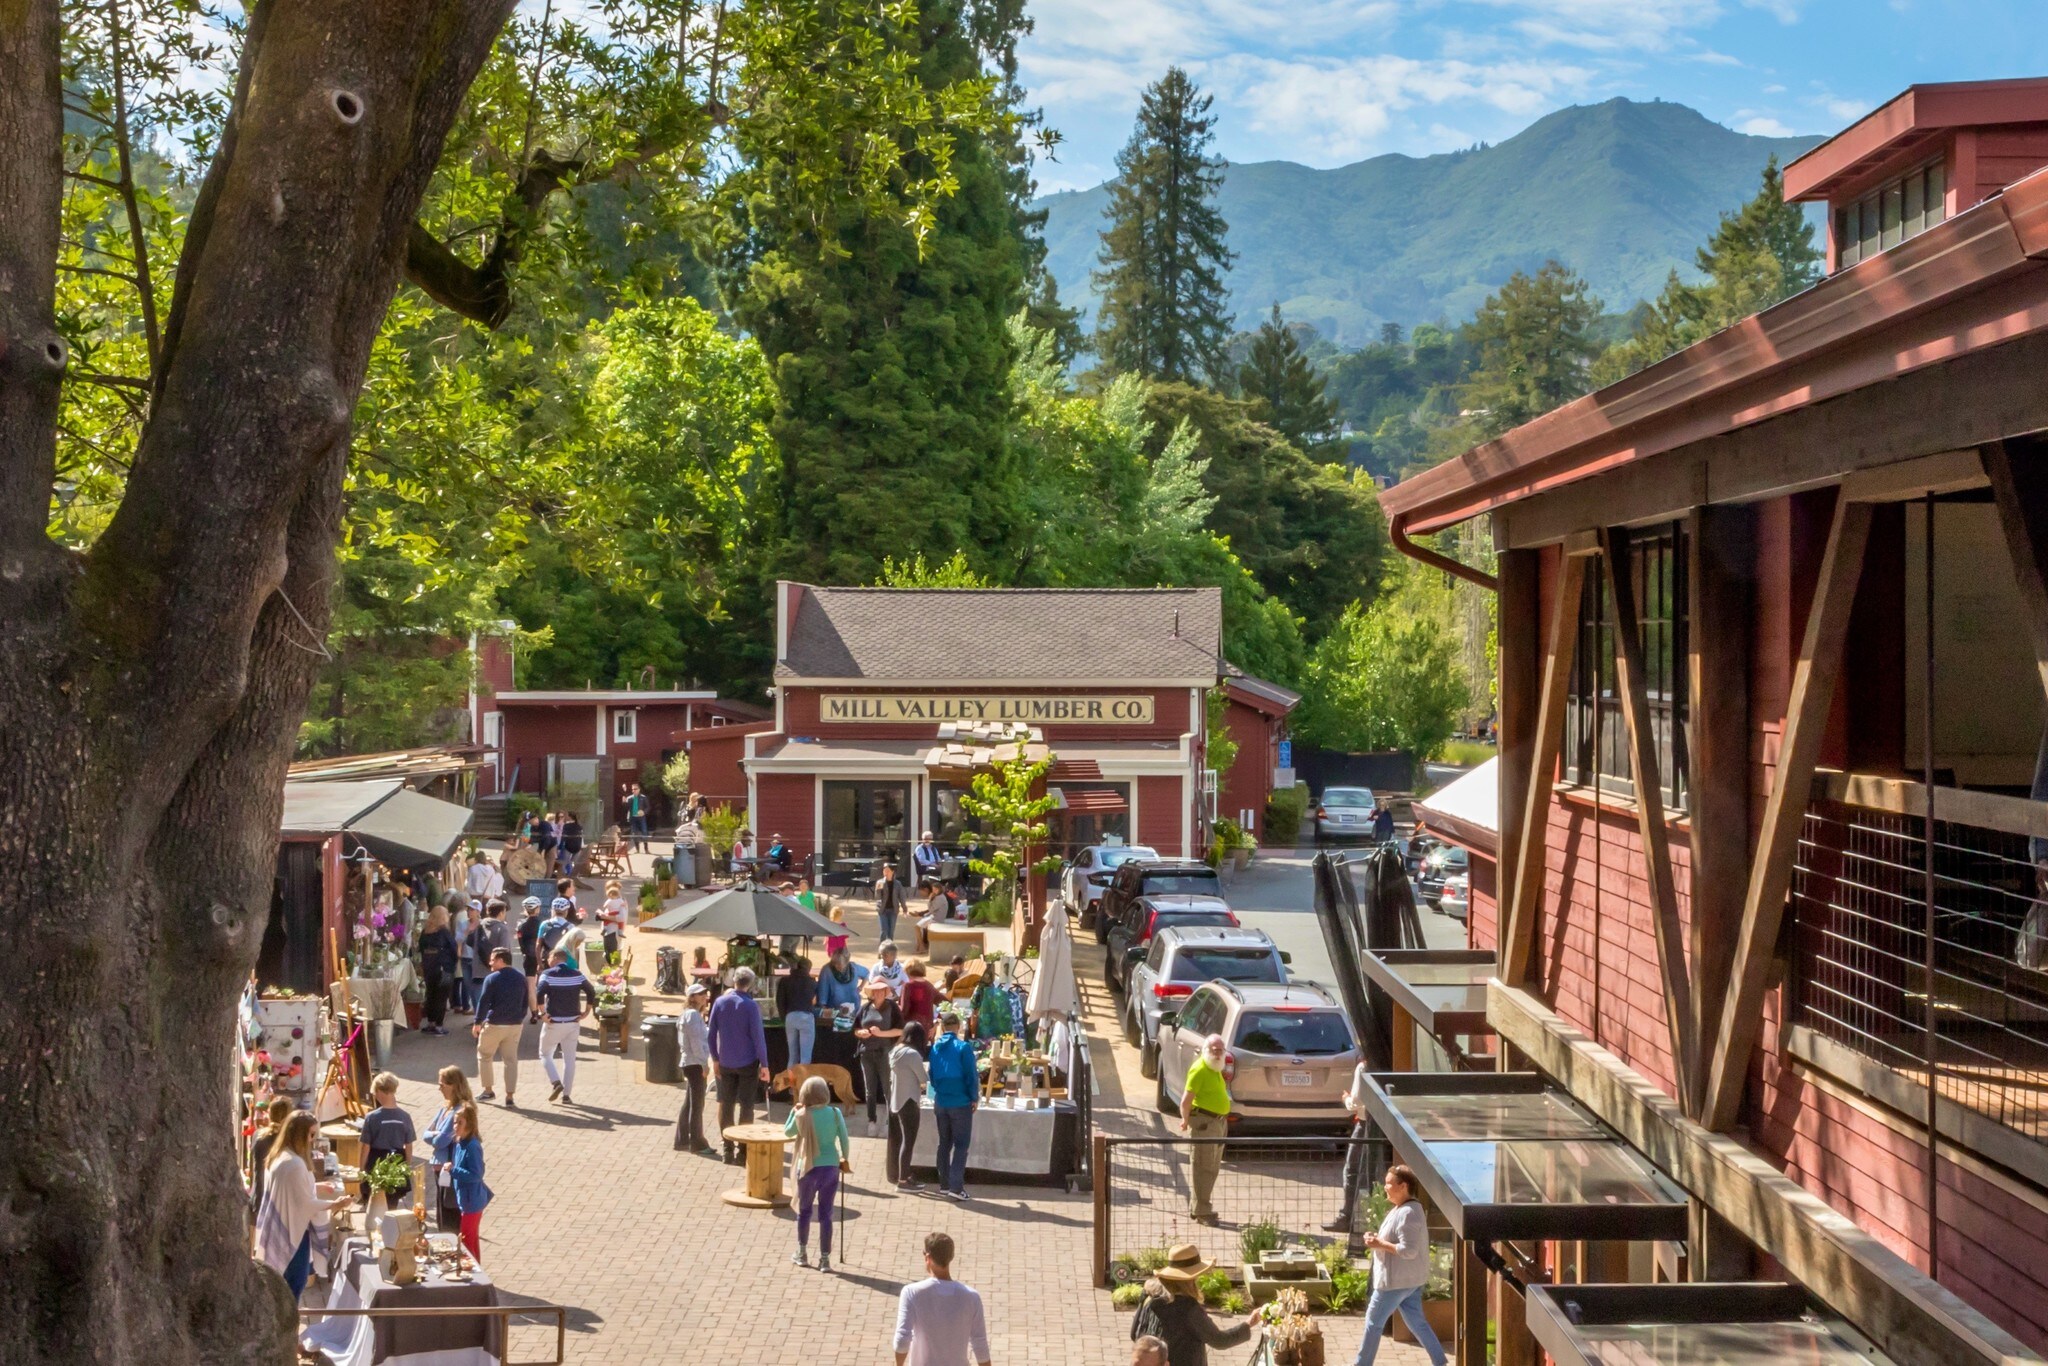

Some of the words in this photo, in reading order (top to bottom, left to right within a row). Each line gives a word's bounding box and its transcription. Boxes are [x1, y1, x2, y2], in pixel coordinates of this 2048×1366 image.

[830, 700, 888, 717] MILL
[896, 700, 990, 717] VALLEY
[1000, 700, 1103, 718] LUMBER
[1112, 700, 1147, 718] CO.
